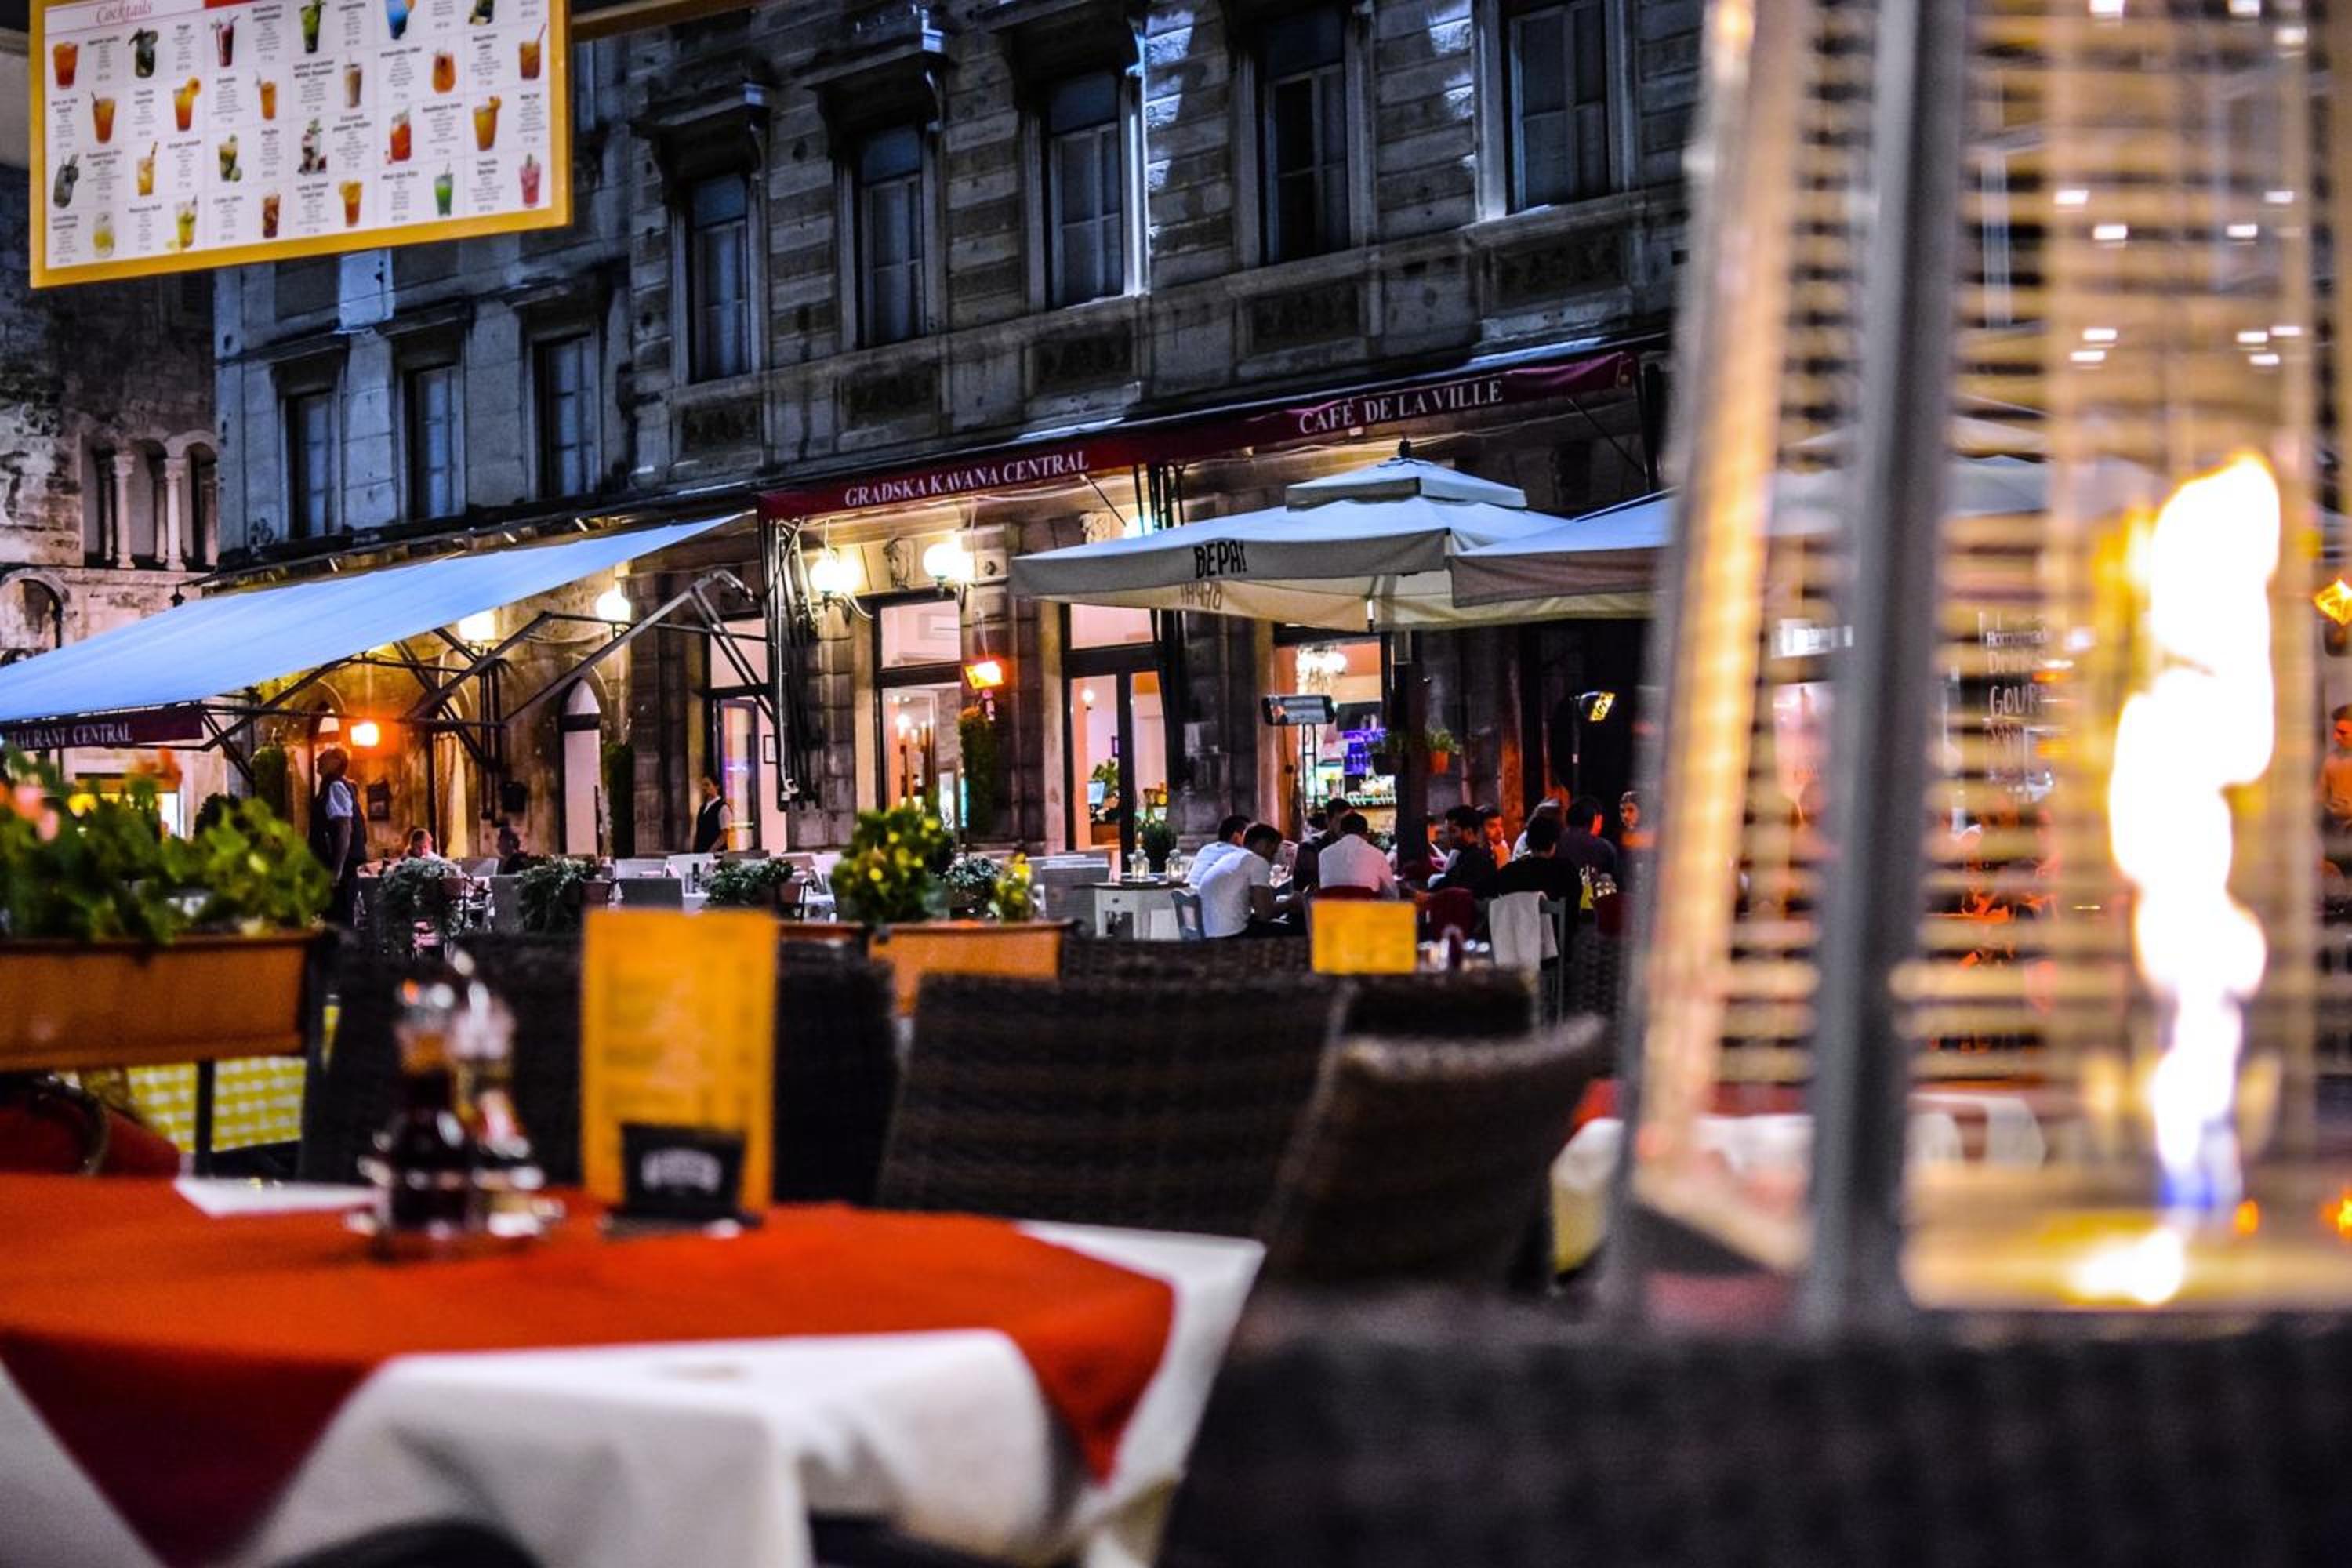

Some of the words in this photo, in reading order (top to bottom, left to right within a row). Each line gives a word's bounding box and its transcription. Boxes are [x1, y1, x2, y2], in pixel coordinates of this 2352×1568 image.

[1364, 397, 1392, 423] DE
[1399, 392, 1428, 418] LA
[1433, 379, 1504, 412] VILLE
[844, 477, 926, 507] GRADSKA
[930, 467, 1000, 494] KAVANA
[1003, 451, 1091, 483] CENTRAL
[73, 722, 132, 745] CENTRAL
